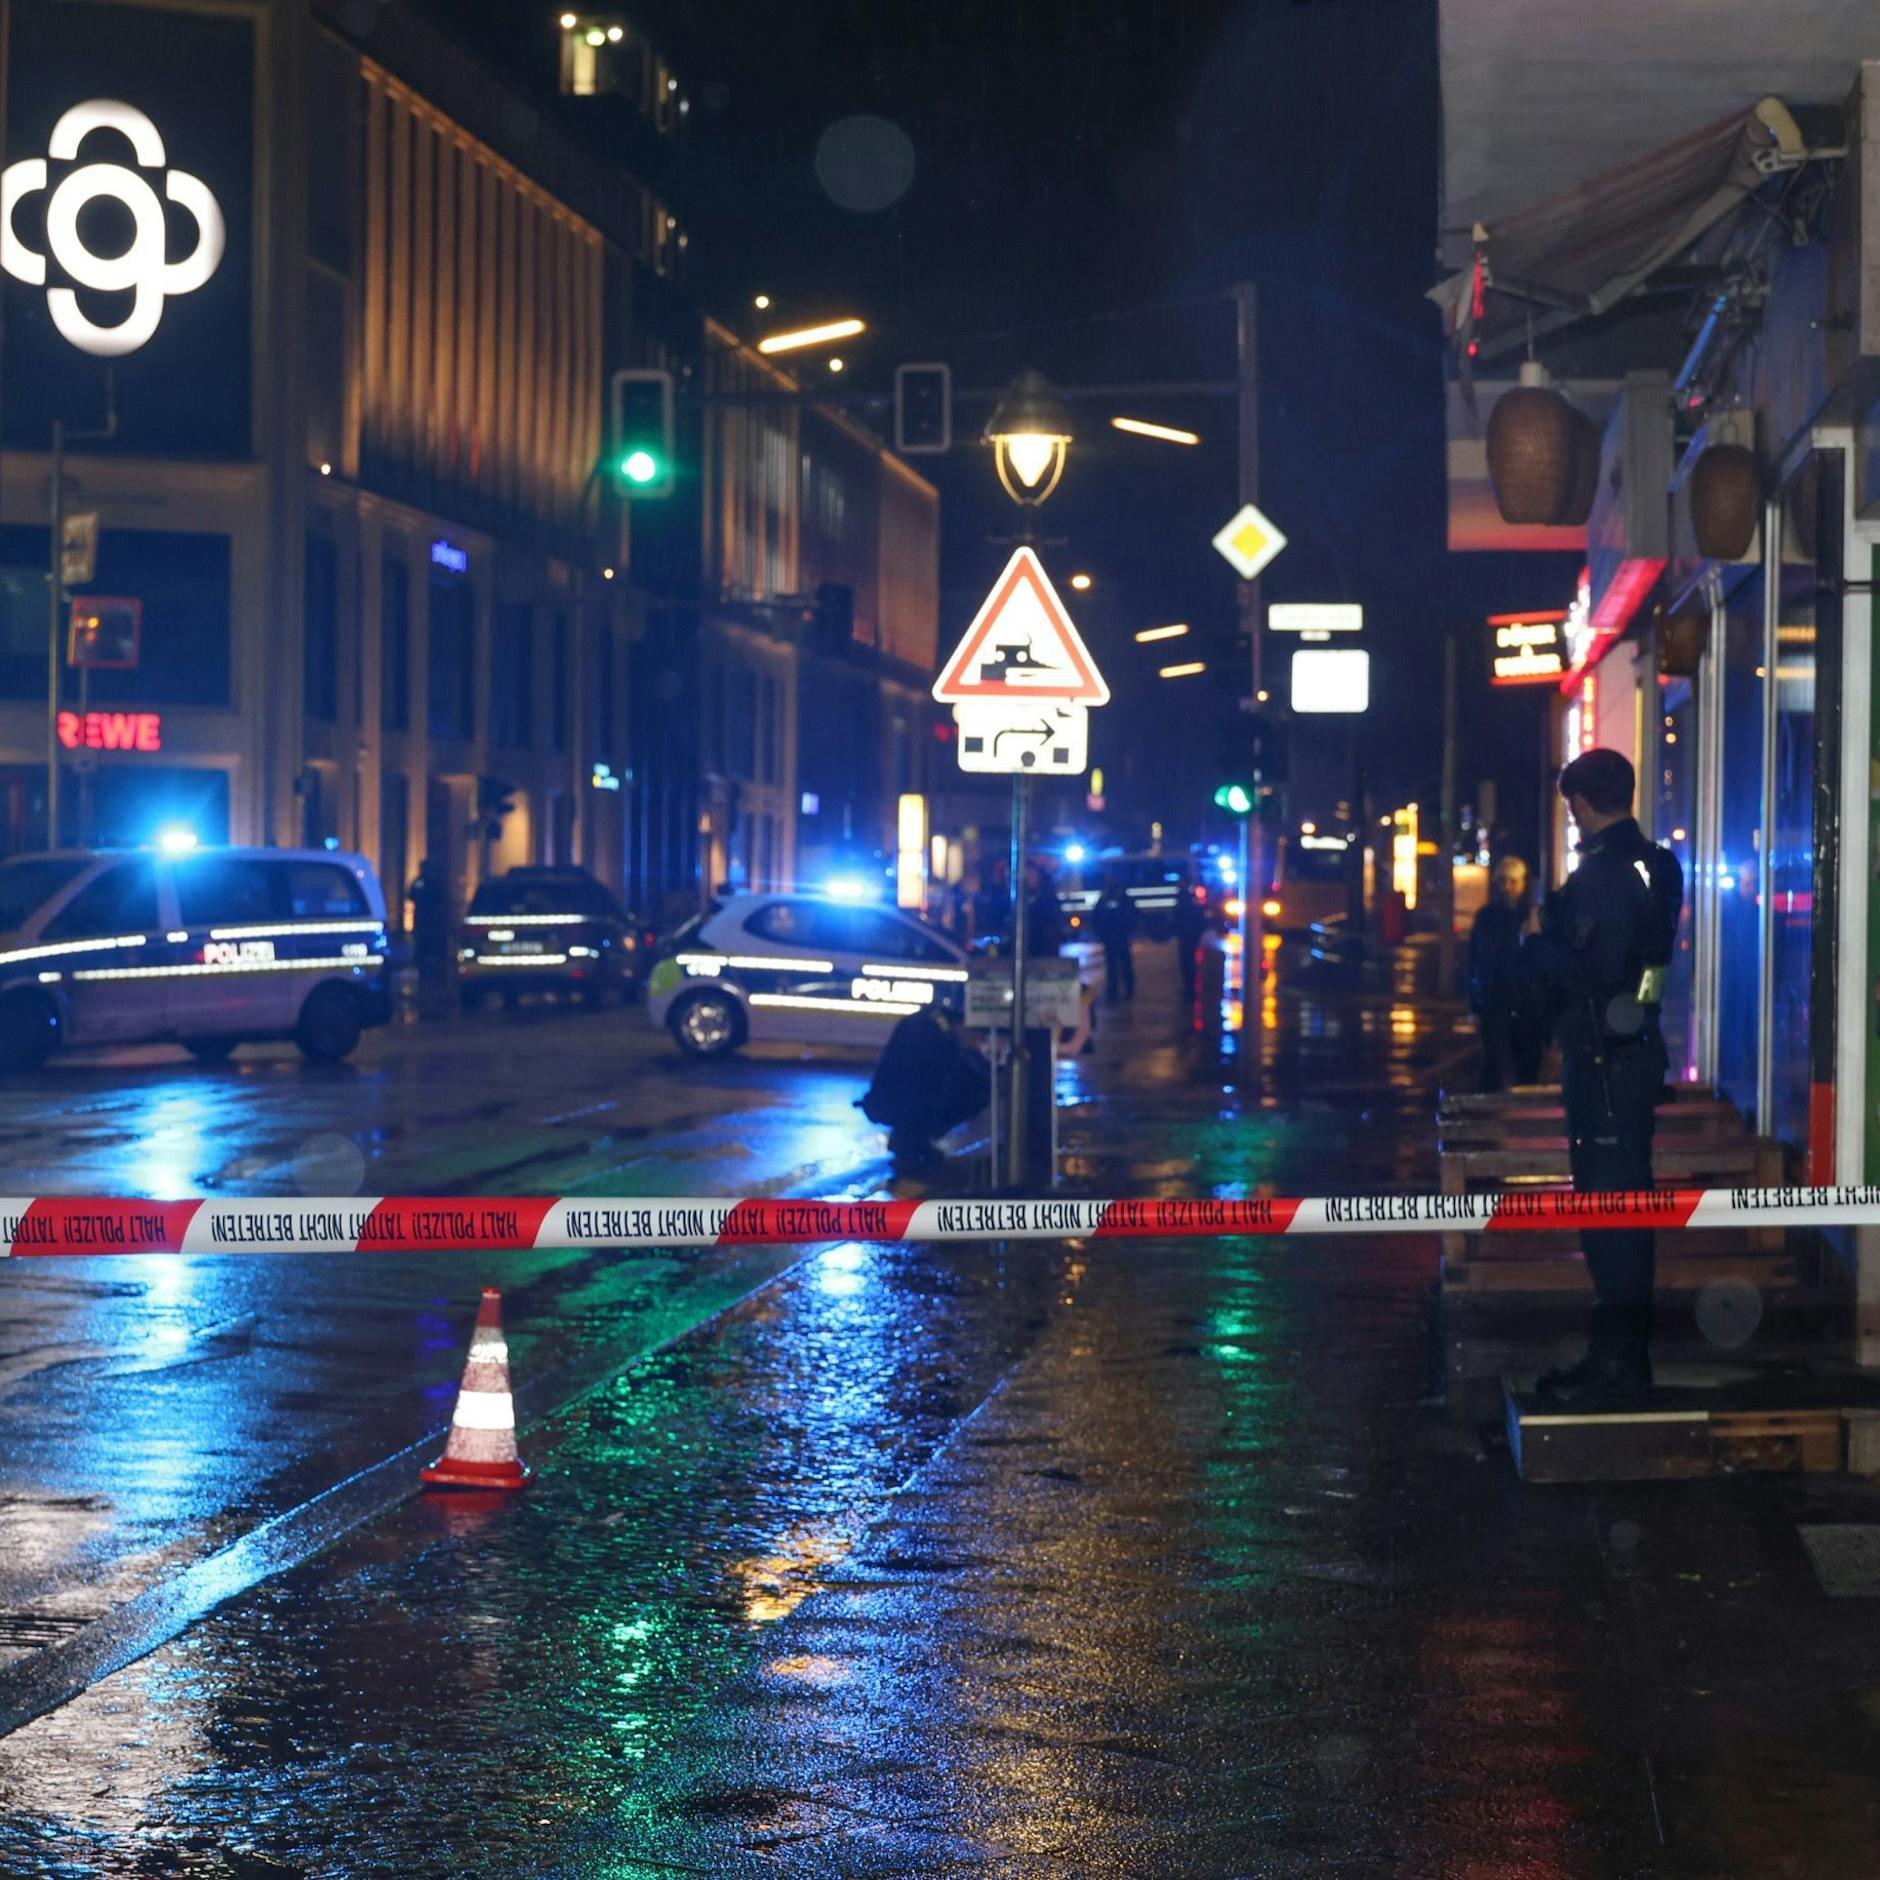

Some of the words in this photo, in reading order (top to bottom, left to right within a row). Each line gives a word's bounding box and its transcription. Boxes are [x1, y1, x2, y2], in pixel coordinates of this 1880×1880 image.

[58, 711, 161, 751] REWE
[1424, 1194, 1475, 1219] NICHT
[1480, 1192, 1545, 1217] TATORT
[1834, 1186, 1880, 1205] ICHT
[412, 1212, 474, 1241] POLIZEI!
[480, 1211, 519, 1239] HALT
[565, 1210, 651, 1238] BETRETEN!
[658, 1208, 704, 1237] NICHT
[709, 1208, 769, 1236] TATORT
[776, 1207, 842, 1235] POLIZEI!
[848, 1206, 888, 1233] HALT
[937, 1204, 1027, 1232] BETRETEN!
[1032, 1203, 1082, 1230] NICHT
[1087, 1203, 1149, 1229] TATORT
[1156, 1201, 1225, 1227] POLIZEI!
[1230, 1200, 1272, 1225] HALT
[3, 1215, 56, 1243] TATORT
[63, 1215, 125, 1244] POLIZEI!
[129, 1215, 168, 1243] HALT
[210, 1213, 294, 1242] BETRETEN!
[300, 1213, 345, 1241] NICHT
[349, 1213, 406, 1241] TATORT
